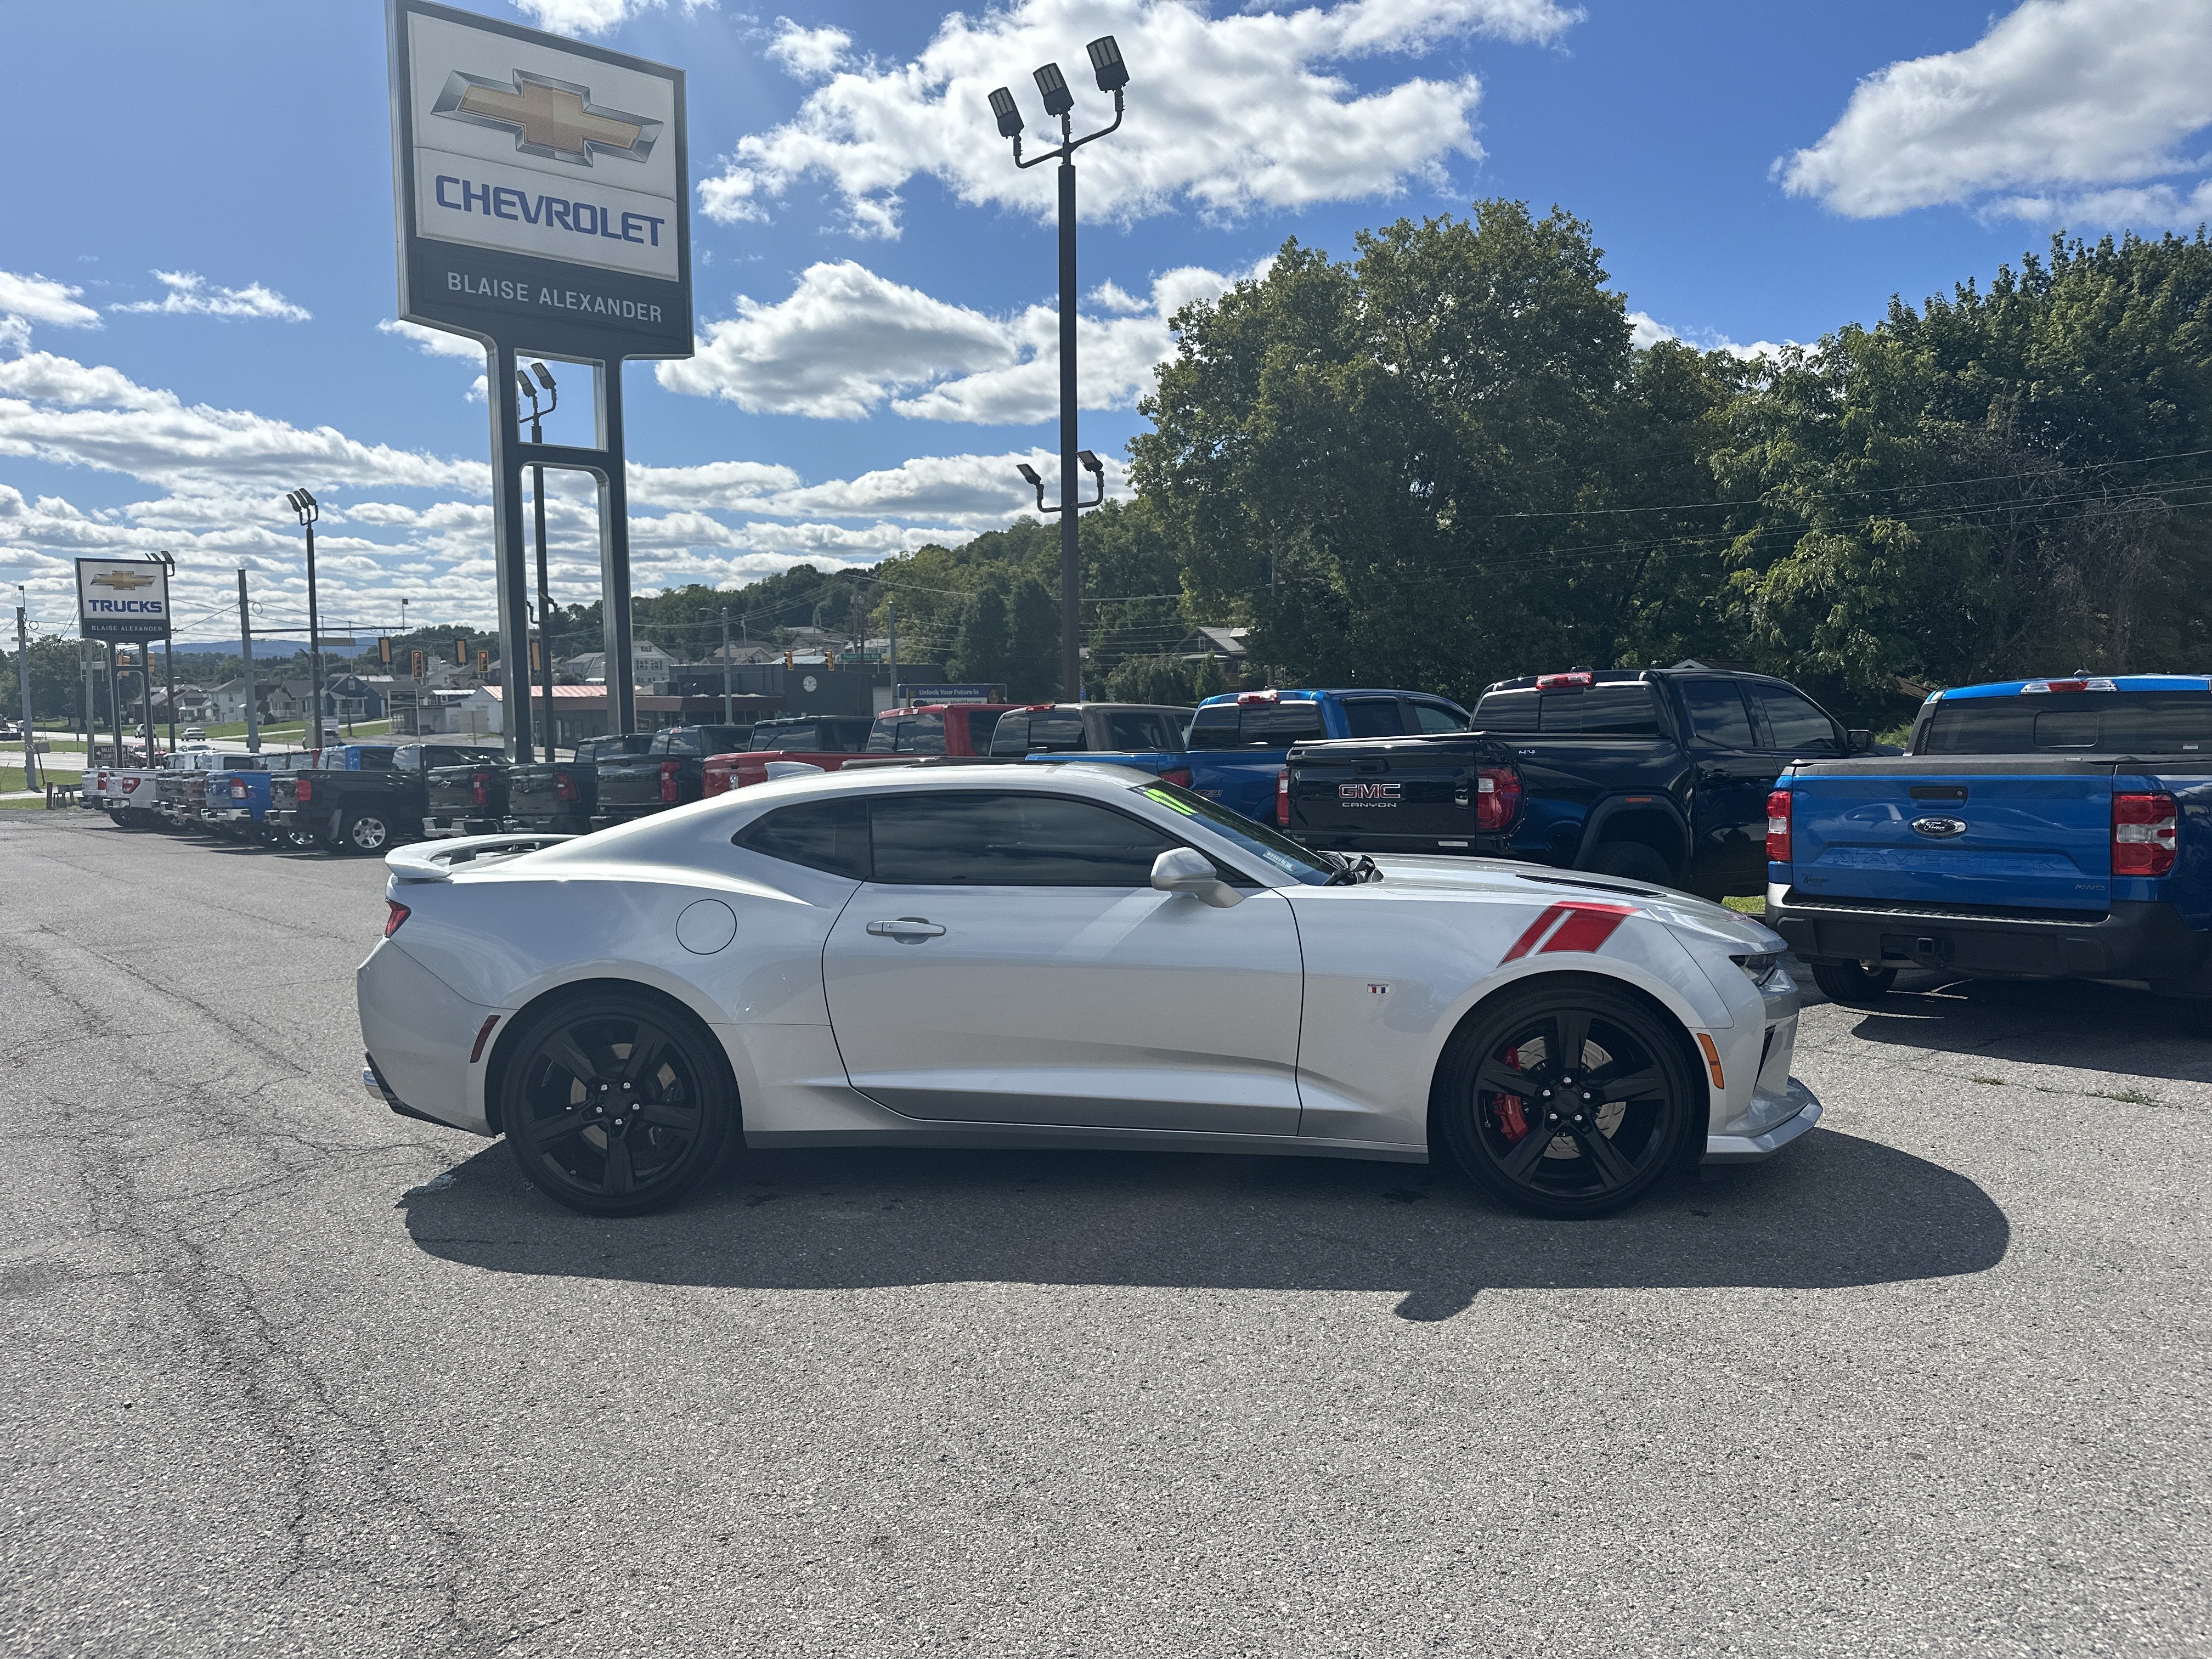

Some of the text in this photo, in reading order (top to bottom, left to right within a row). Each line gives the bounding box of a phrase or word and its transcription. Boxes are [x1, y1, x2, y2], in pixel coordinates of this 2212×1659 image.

[436, 175, 665, 246] CHEVROLET
[448, 272, 662, 323] BLAISE ALEXANDER
[88, 599, 162, 613] TRUCKS
[1339, 783, 1401, 799] GMC
[1924, 821, 1947, 831] Ford
[1833, 850, 2058, 872] MAVERICK
